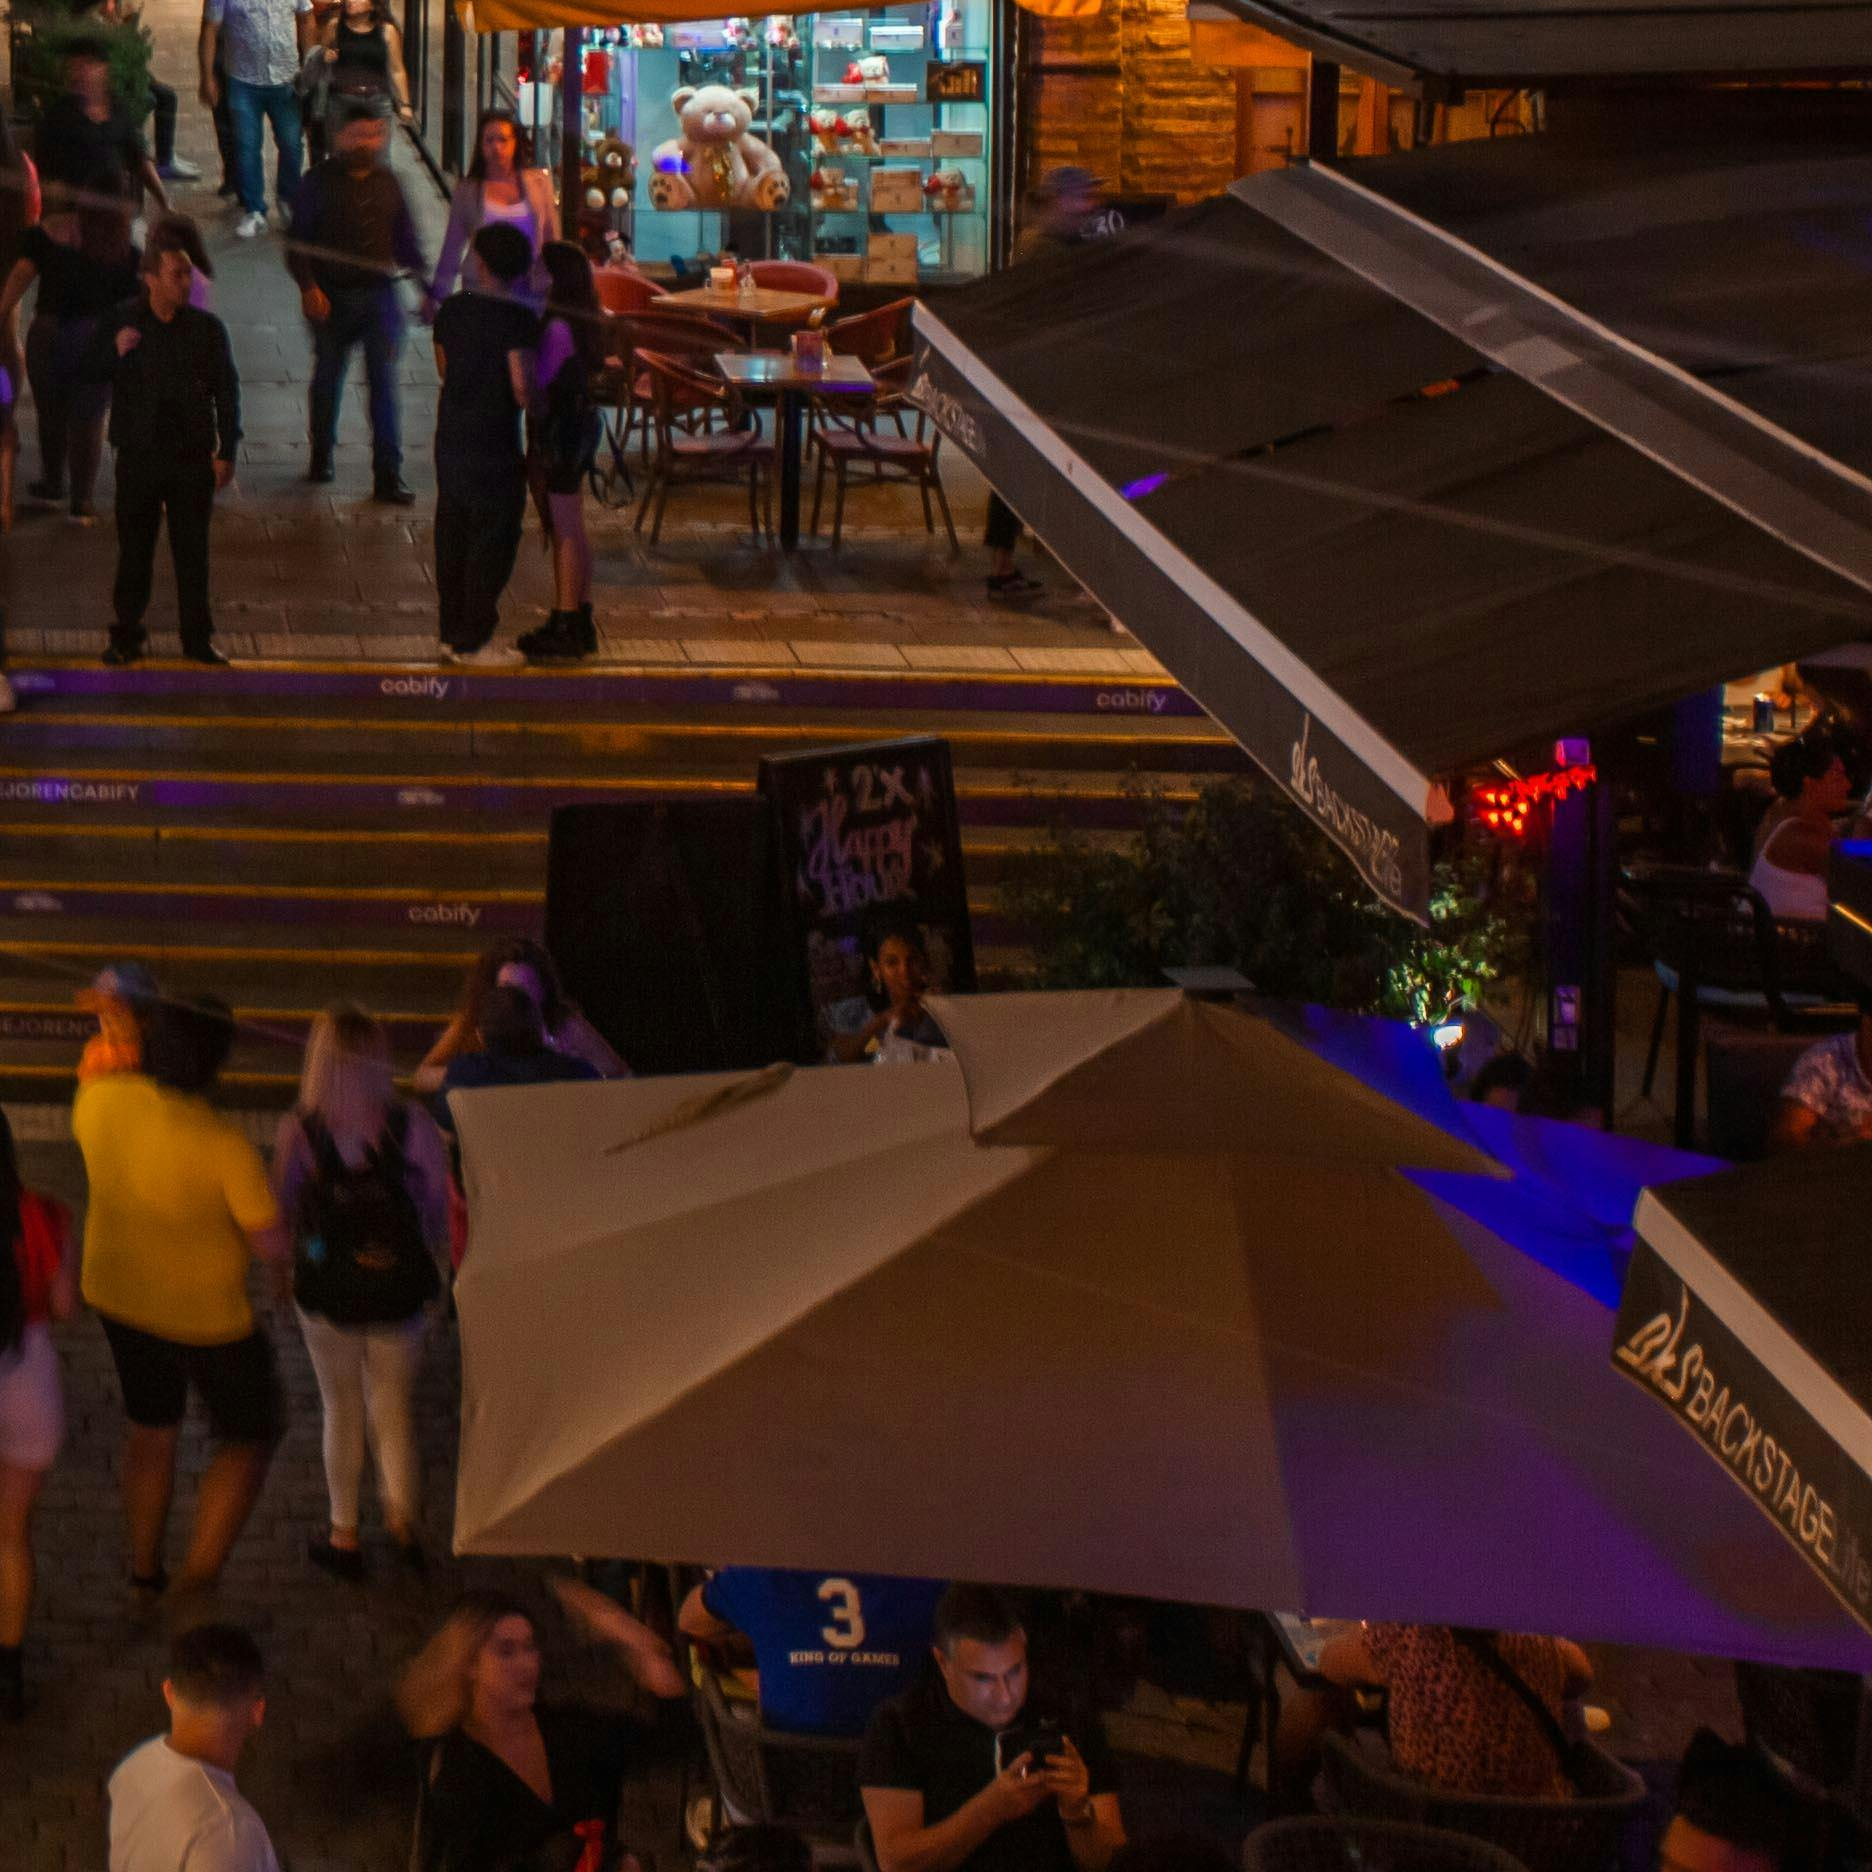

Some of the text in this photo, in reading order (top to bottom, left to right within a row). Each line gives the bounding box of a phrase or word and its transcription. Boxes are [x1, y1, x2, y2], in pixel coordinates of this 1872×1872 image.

[380, 676, 449, 700] cabify
[1096, 689, 1167, 712] cabify
[408, 902, 481, 927] cabify
[1685, 1367, 1834, 1565] BACKSTAGE
[817, 1578, 866, 1648] 3
[789, 1651, 902, 1666] KING OF GAMES
